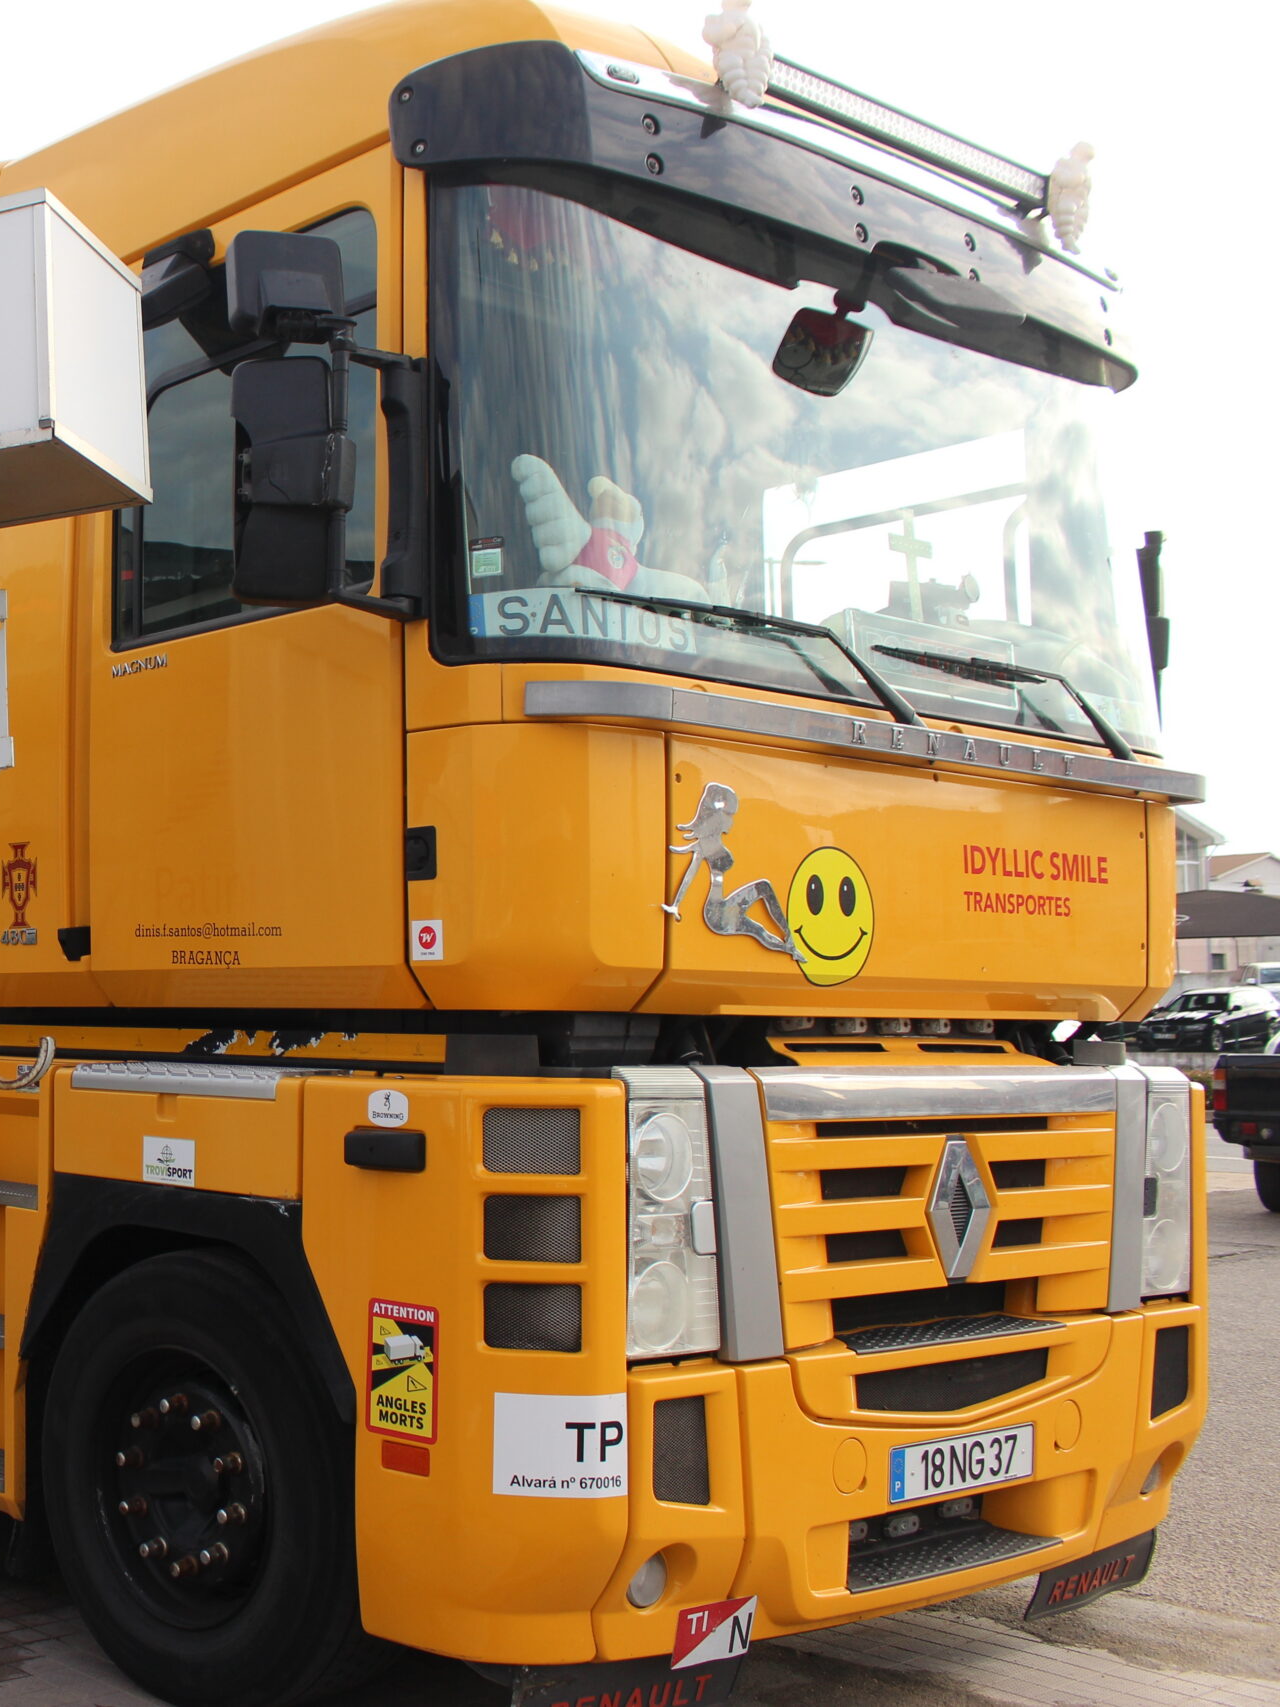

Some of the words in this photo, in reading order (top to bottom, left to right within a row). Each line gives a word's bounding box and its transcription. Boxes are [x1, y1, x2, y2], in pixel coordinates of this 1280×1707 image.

[111, 653, 169, 679] MAGNUM
[851, 720, 1076, 776] RENAULT
[963, 844, 1045, 880] IDYLLIC
[1049, 851, 1109, 884] SMILE
[963, 890, 1071, 917] TRANSPORTES
[134, 922, 283, 940] dinis.f.santos@hotmail.com
[171, 950, 241, 969] BRAGANÇA
[372, 1110, 404, 1121] BROWNING
[145, 1164, 193, 1180] TROVISPORT
[373, 1303, 435, 1323] ATTENTION
[376, 1394, 427, 1415] ANGLES
[378, 1409, 424, 1430] MORTS
[565, 1421, 623, 1463] TP
[510, 1474, 556, 1489] Alvará
[579, 1475, 622, 1490] 670016
[894, 1480, 902, 1493] P
[1048, 1554, 1136, 1606] RENAULT
[687, 1611, 708, 1635] TI
[728, 1612, 753, 1653] N
[550, 1674, 713, 1707] NAULT
